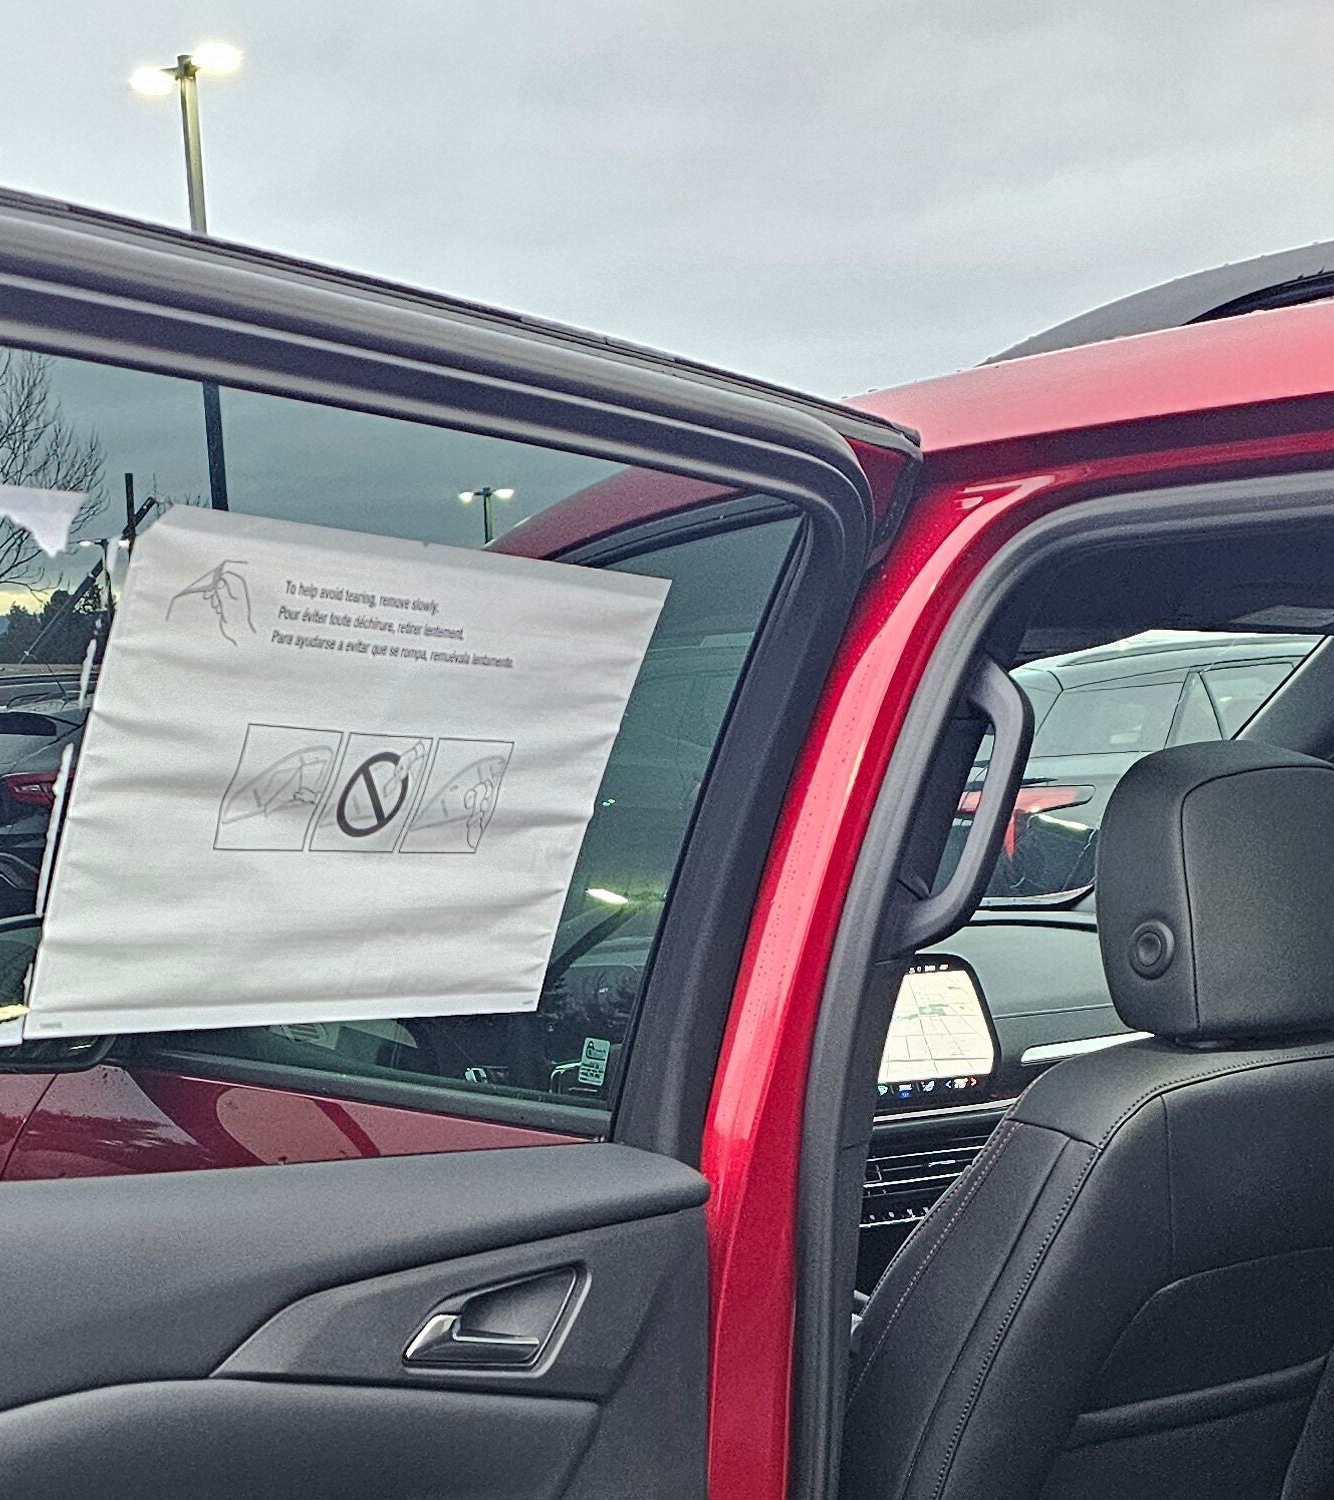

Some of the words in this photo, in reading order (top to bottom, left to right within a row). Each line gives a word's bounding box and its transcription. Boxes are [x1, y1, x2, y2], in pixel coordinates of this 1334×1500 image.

[285, 580, 296, 595] To
[298, 582, 318, 600] help
[319, 586, 344, 601] avoid
[379, 595, 410, 610] remove
[278, 605, 300, 620] Pour
[302, 607, 328, 624] éviter
[329, 612, 352, 628] toute
[397, 620, 423, 636] retirer
[271, 629, 293, 645] Para
[294, 634, 336, 651] ayudarse
[336, 640, 344, 652] a
[345, 639, 371, 654] evitar
[371, 643, 387, 658] que
[389, 646, 400, 658] se
